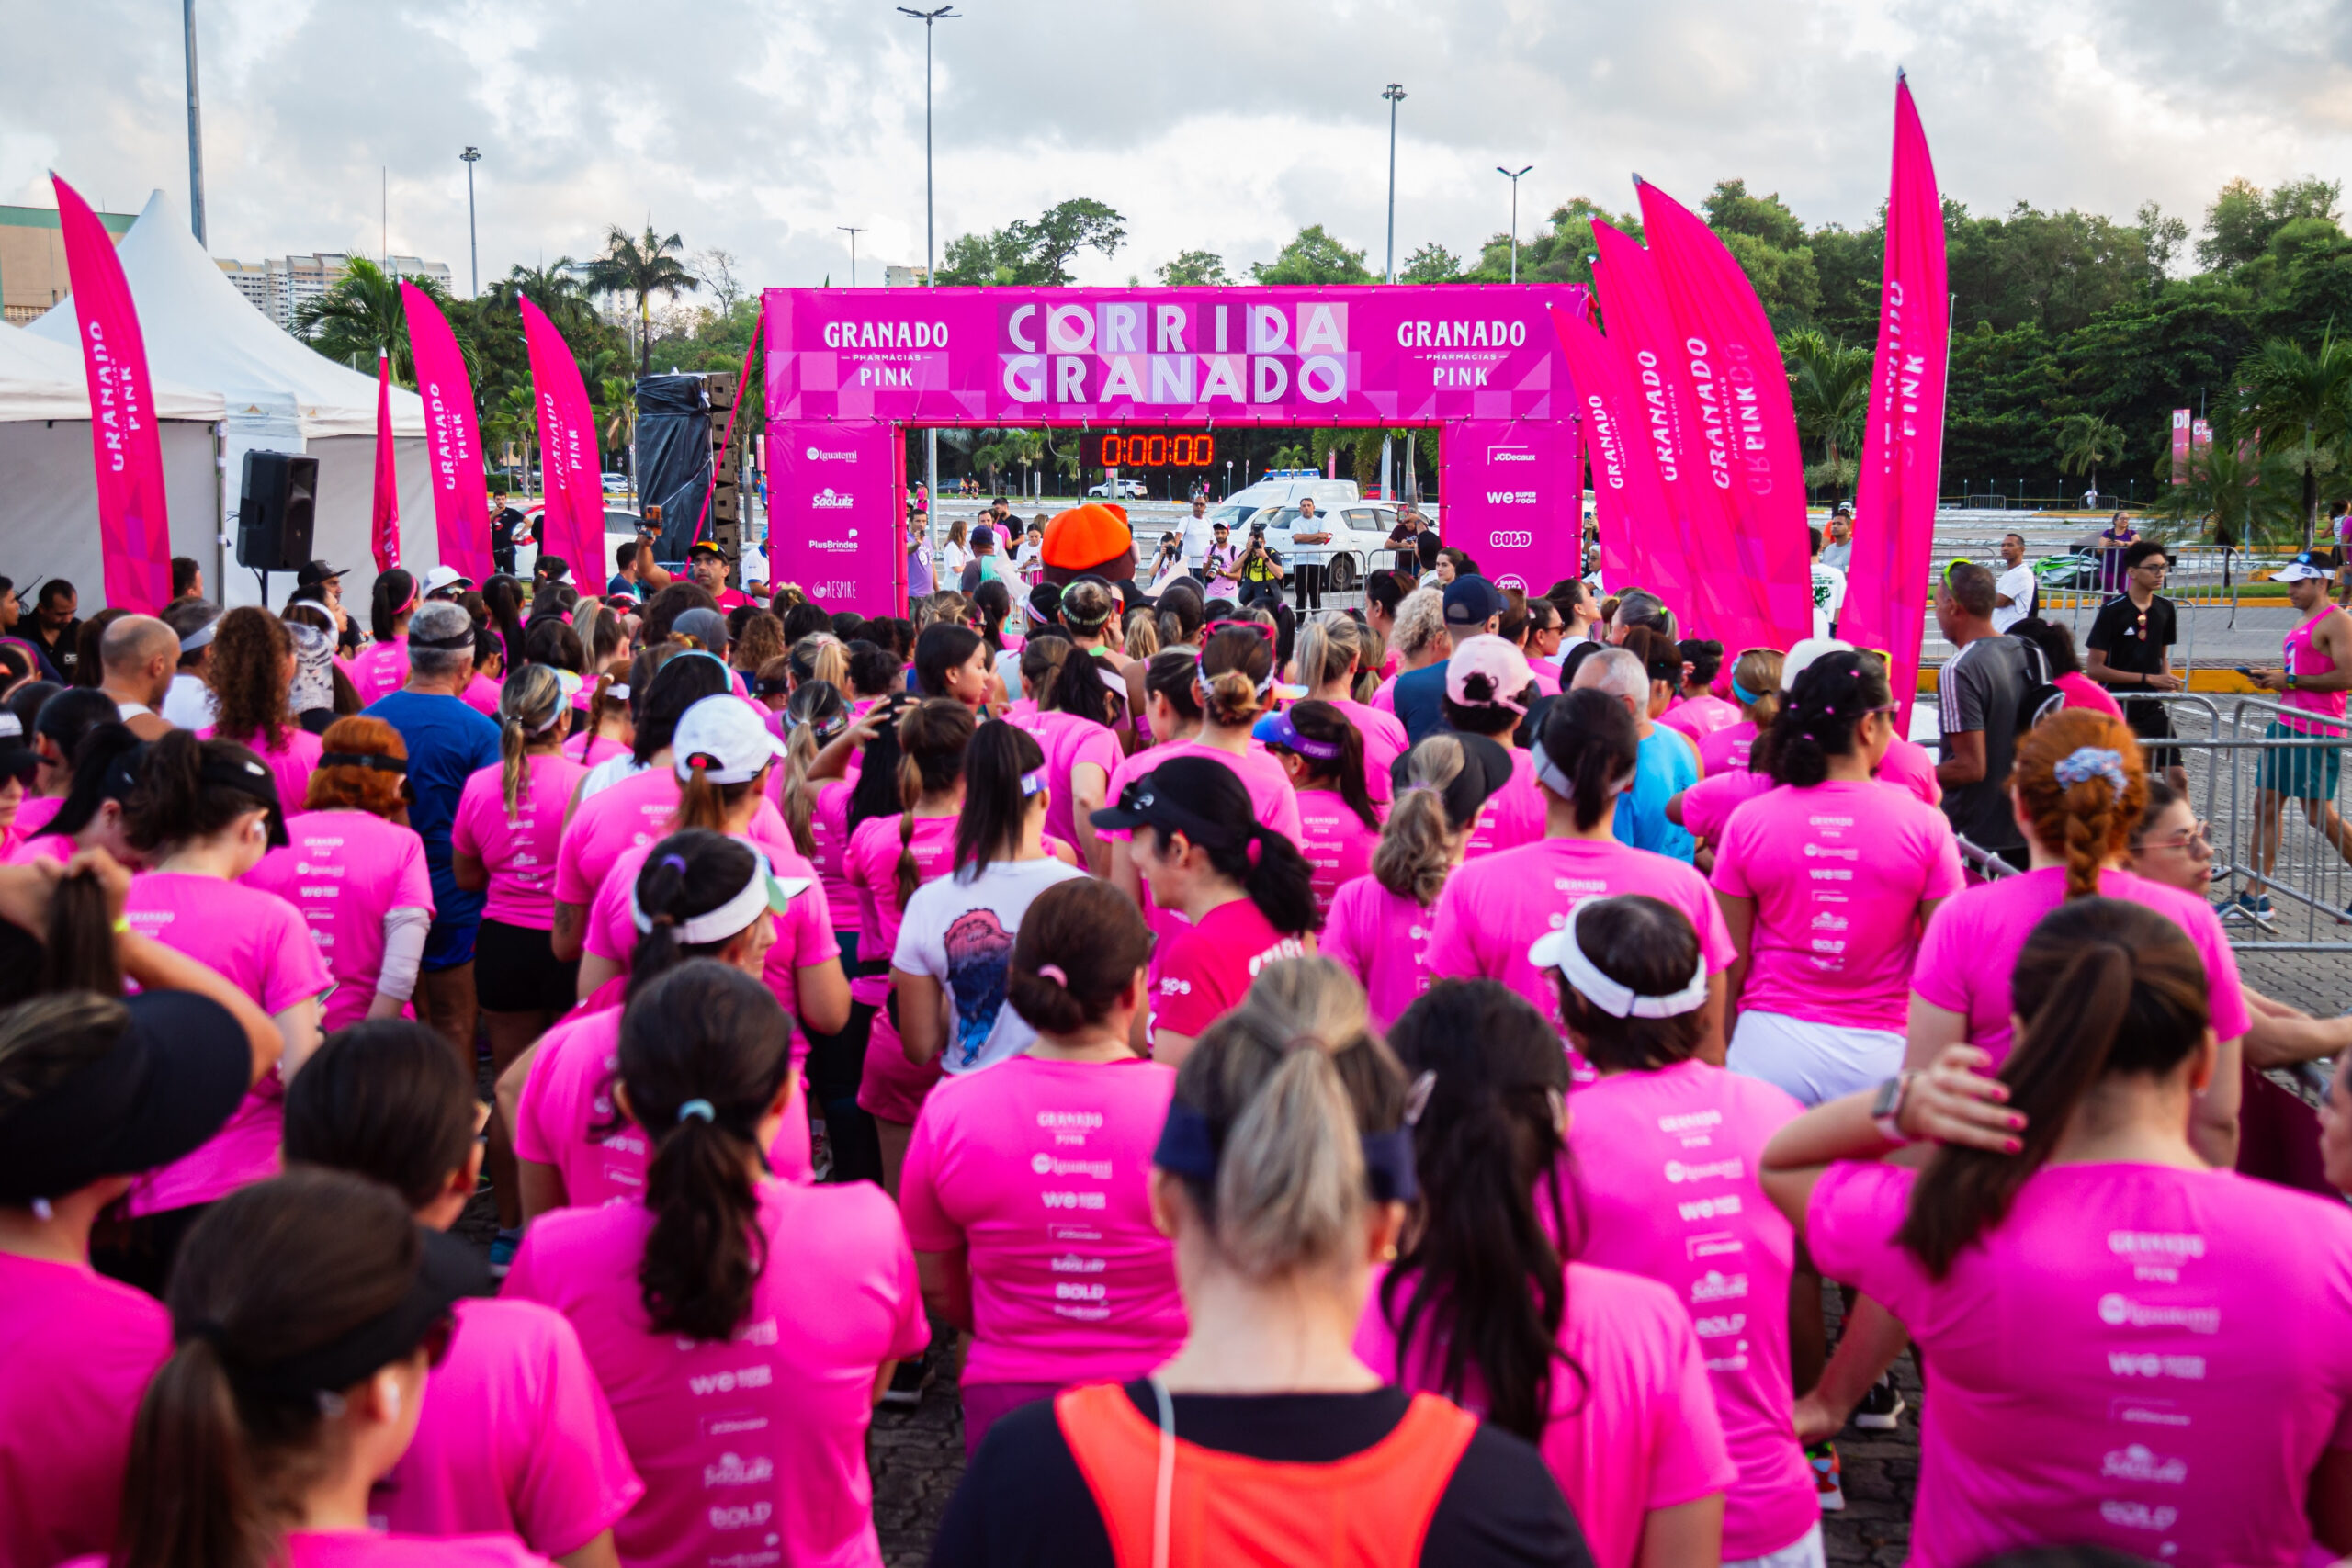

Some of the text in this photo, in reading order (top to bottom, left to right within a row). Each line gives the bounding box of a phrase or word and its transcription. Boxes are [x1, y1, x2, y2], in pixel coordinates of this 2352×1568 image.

[824, 321, 949, 347] GRANADO
[1009, 305, 1345, 353] CORRIDA
[1397, 321, 1526, 347] GRANADO
[860, 368, 913, 386] PINK
[1003, 355, 1345, 403] GRANADO
[1433, 367, 1487, 386] PINK
[120, 367, 141, 430] PINK
[1686, 337, 1731, 490] GRANADO
[1637, 350, 1678, 481] GRANADO
[1735, 386, 1765, 450] PINK
[452, 413, 469, 459] PINK
[569, 429, 582, 469] PINK
[1102, 434, 1213, 466] 0:00:00
[1589, 395, 1623, 490] GRANADO
[1494, 453, 1536, 461] JCDecaux
[1487, 491, 1514, 504] we
[808, 540, 858, 549] PlusBrindes
[1490, 531, 1532, 547] BOLD
[827, 581, 856, 599] RESPIRE
